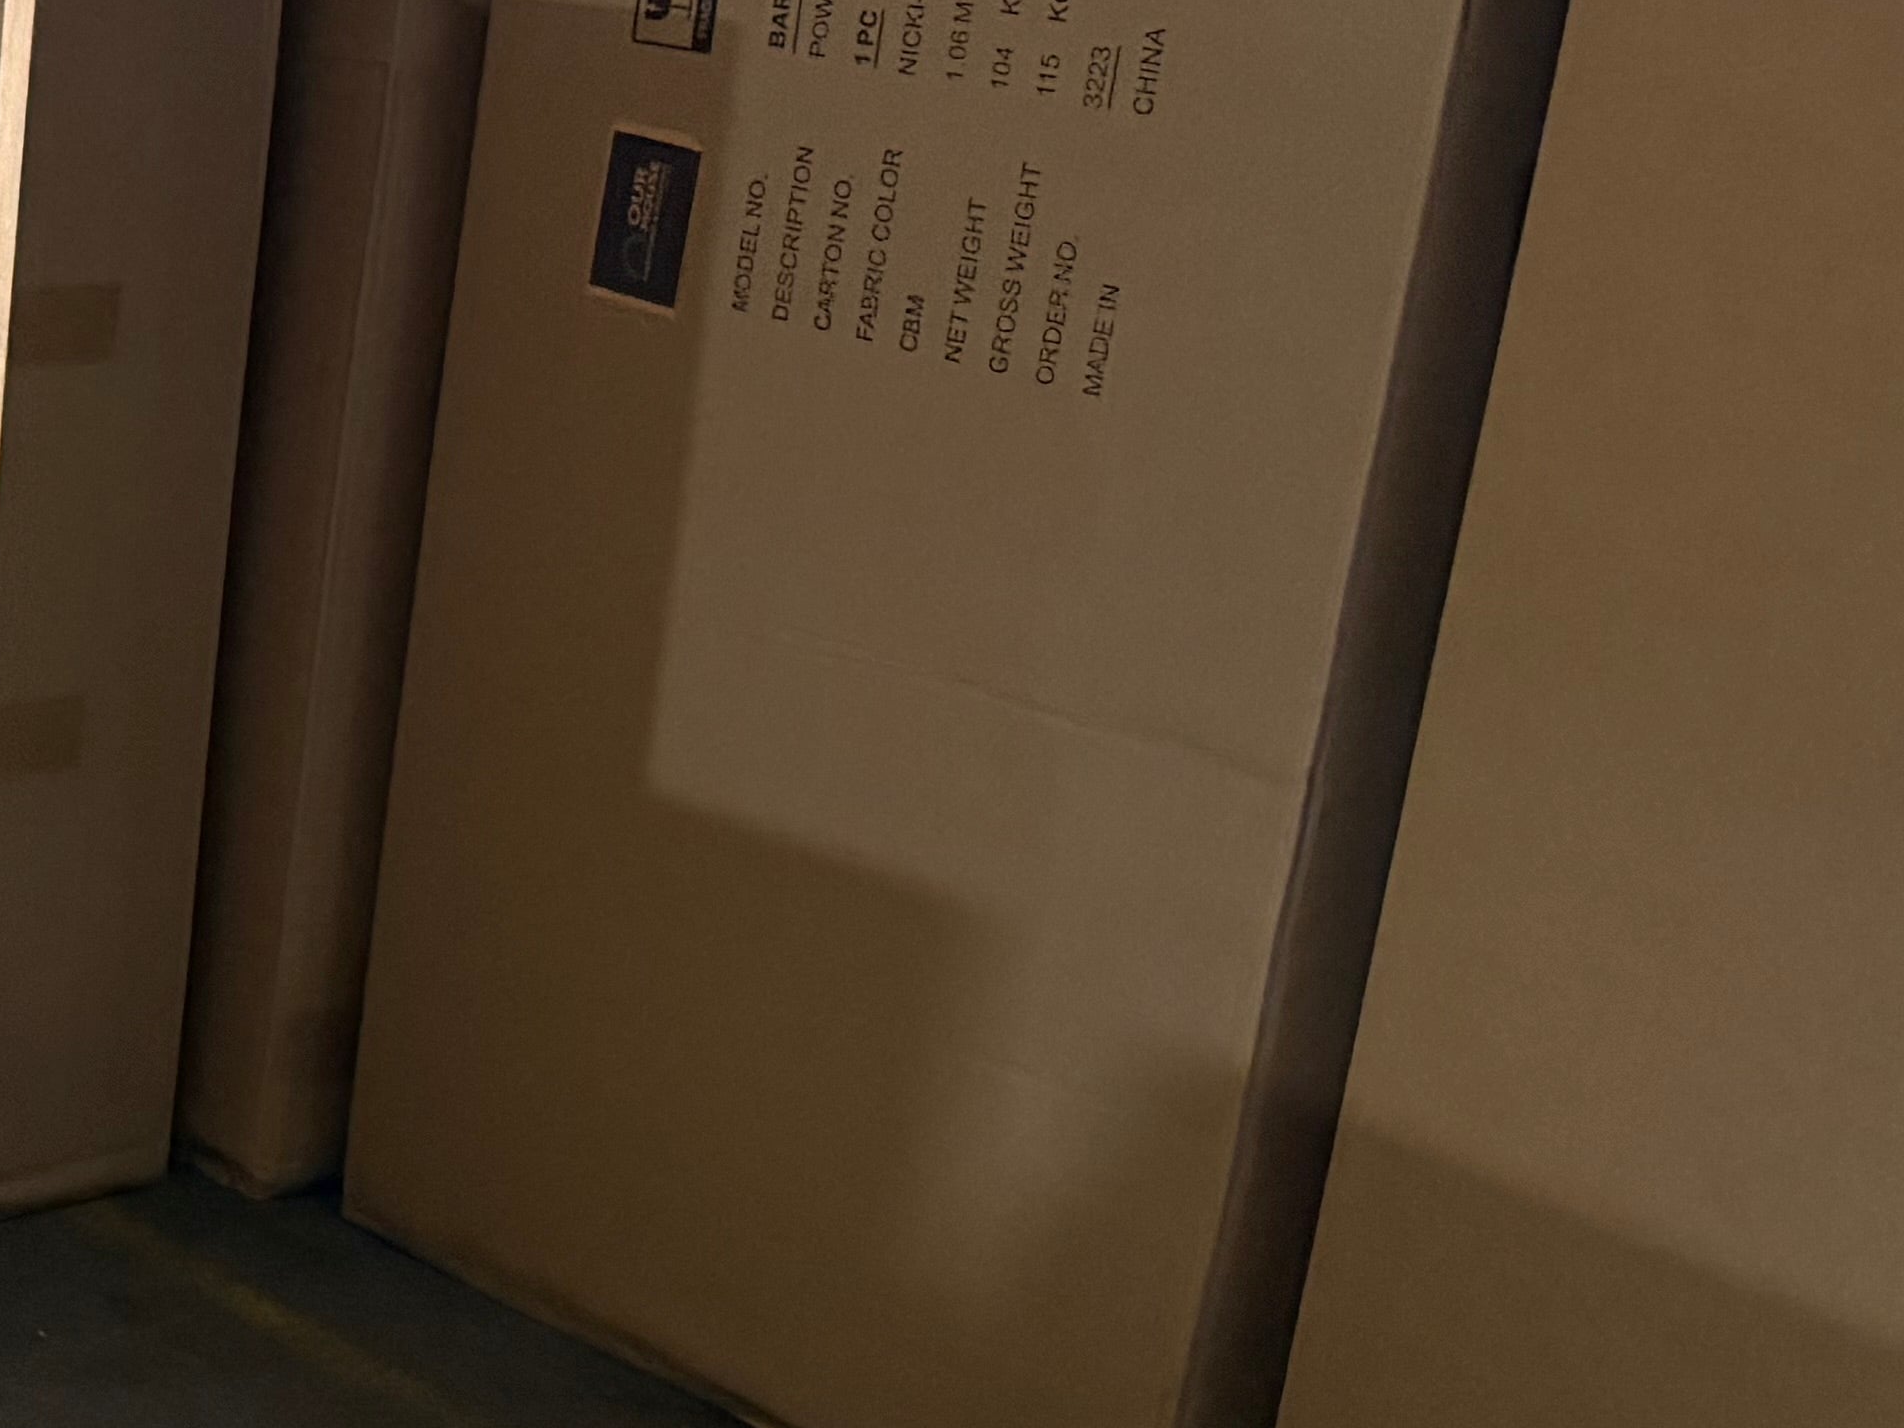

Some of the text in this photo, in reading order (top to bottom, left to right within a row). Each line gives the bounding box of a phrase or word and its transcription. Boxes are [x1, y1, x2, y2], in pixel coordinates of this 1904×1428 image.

[854, 10, 878, 65] 1 PC
[946, 30, 970, 80] 1.06
[990, 46, 1014, 88] 104
[1036, 53, 1061, 95] 115
[1083, 45, 1111, 109] 3223
[1133, 28, 1167, 115] CHINA
[627, 166, 650, 227] OUR
[772, 145, 814, 321] DESCRIPTION
[732, 173, 769, 313] MODEL NO.
[814, 173, 854, 331] CARTON NO.
[856, 149, 904, 341] FABRIC COLOR
[944, 196, 986, 363] NET WEIGHT
[989, 161, 1041, 373] GROSS WEIGHT
[899, 294, 925, 352] CBM
[1035, 288, 1068, 384] ORDER
[1082, 283, 1120, 396] MADE IN
